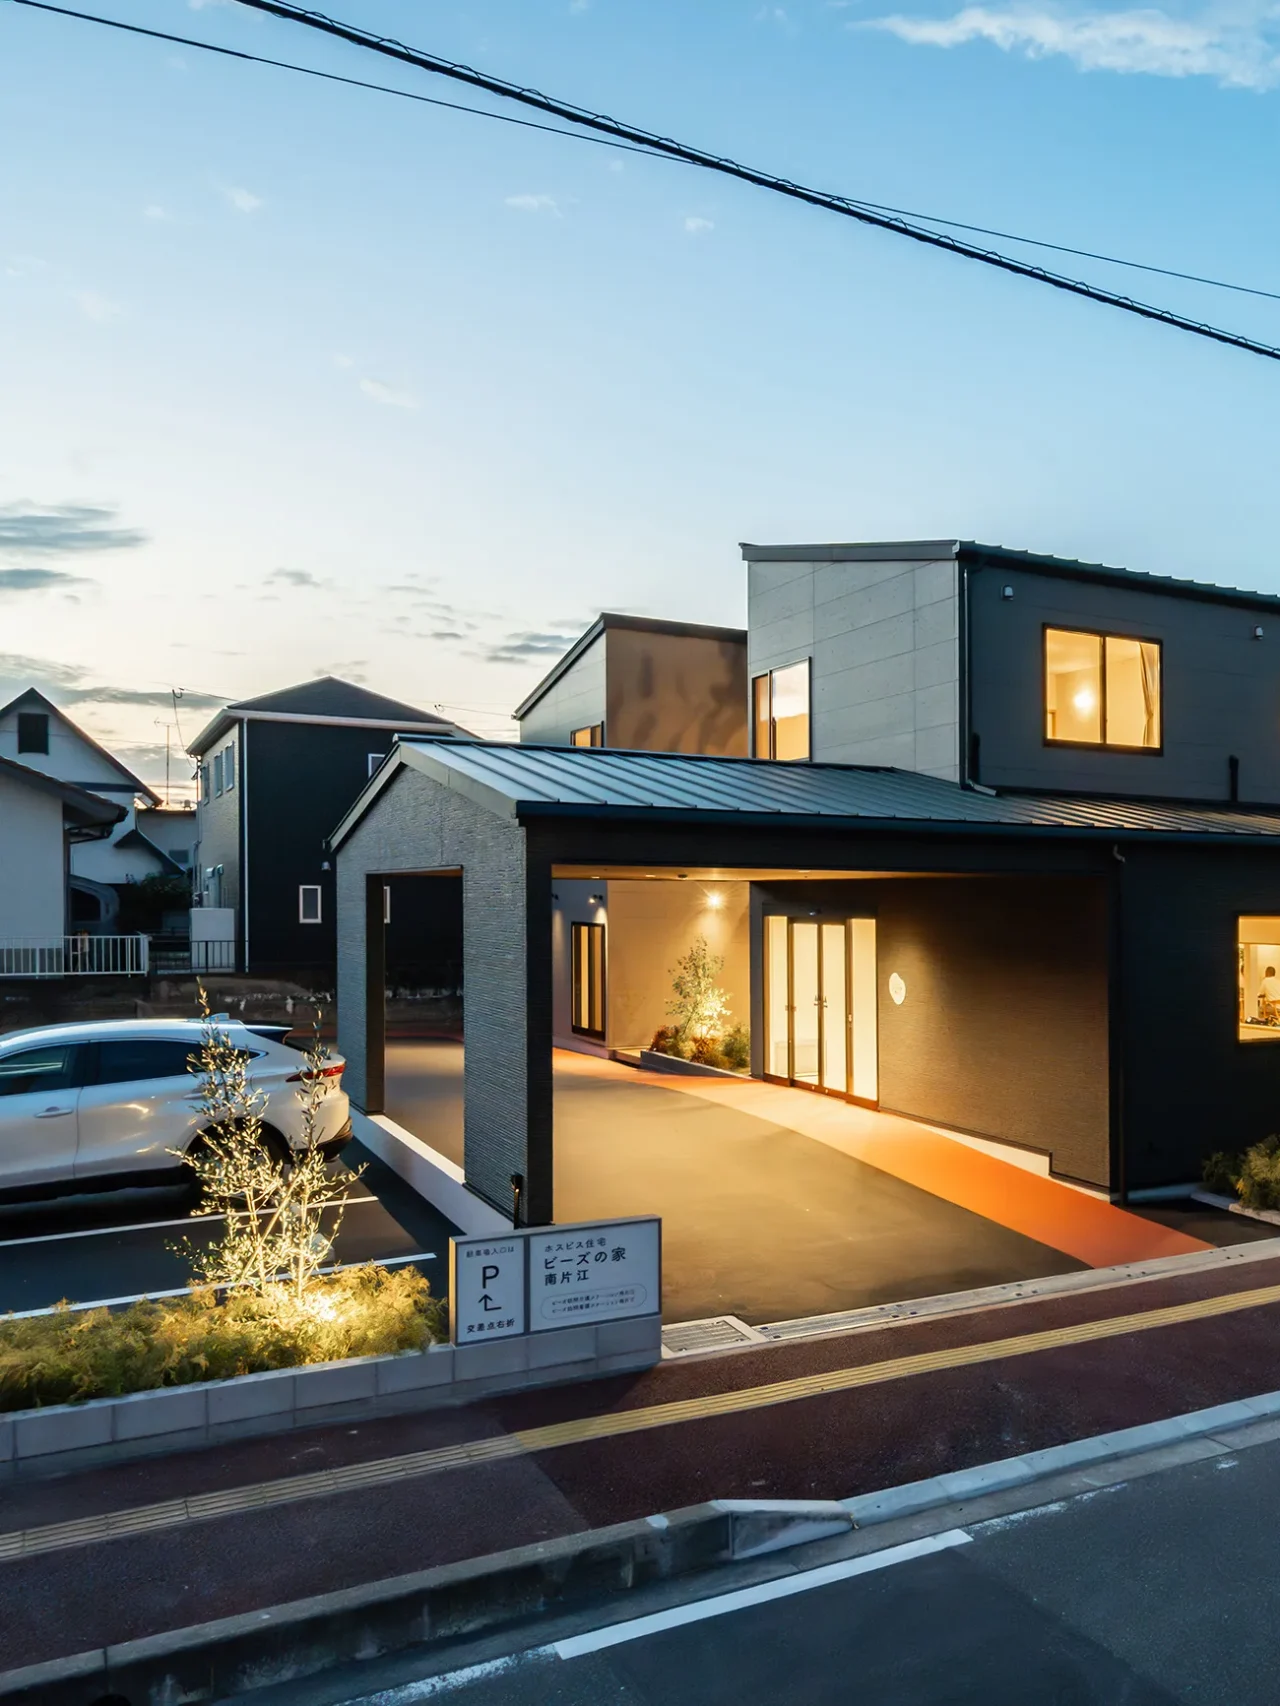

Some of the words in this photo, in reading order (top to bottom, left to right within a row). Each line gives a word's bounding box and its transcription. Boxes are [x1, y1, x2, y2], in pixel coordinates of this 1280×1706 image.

[544, 1246, 627, 1270] ビーズの家
[482, 1265, 499, 1289] P
[544, 1269, 590, 1286] 南片江
